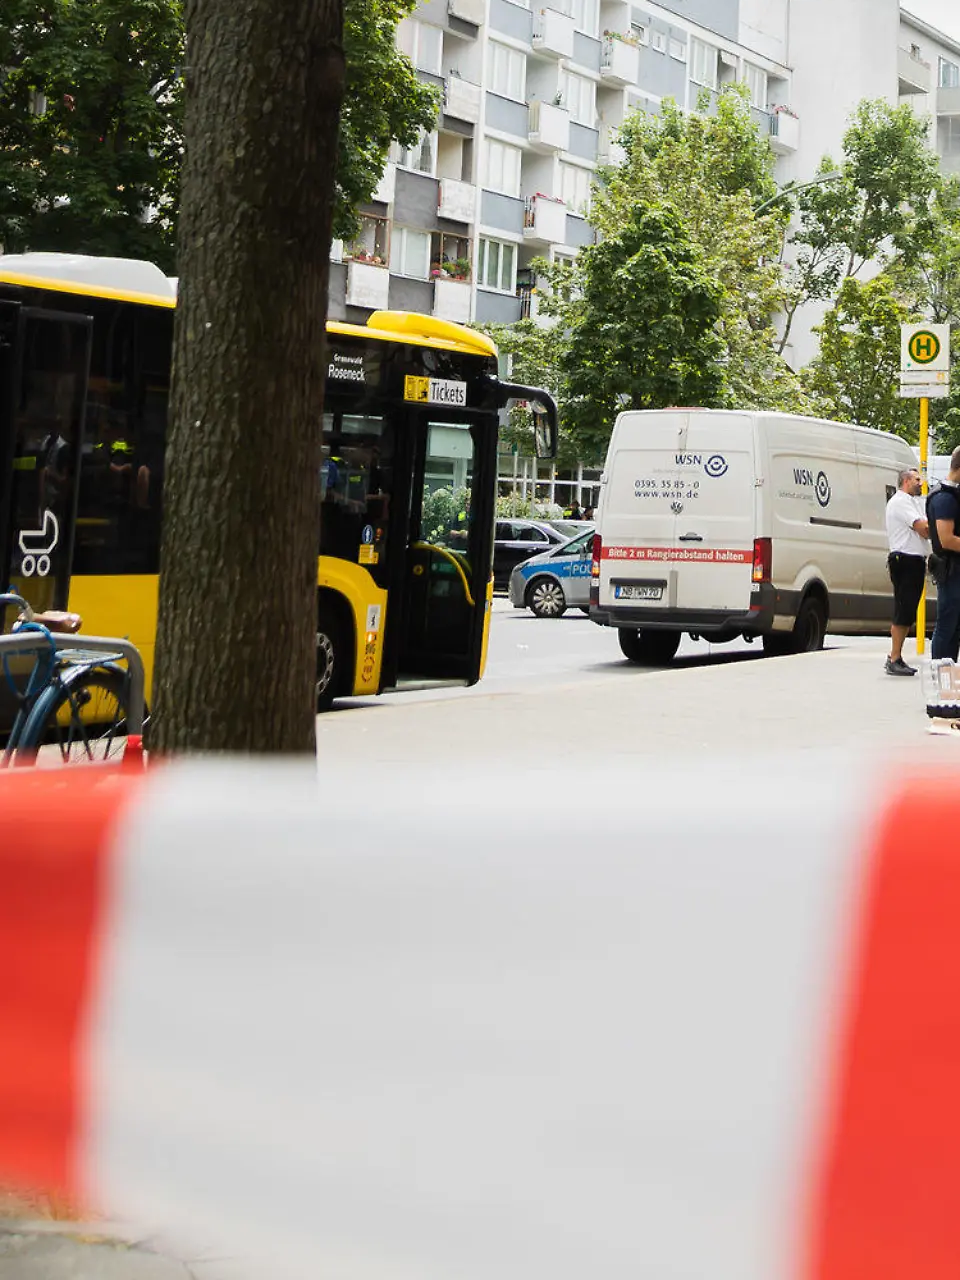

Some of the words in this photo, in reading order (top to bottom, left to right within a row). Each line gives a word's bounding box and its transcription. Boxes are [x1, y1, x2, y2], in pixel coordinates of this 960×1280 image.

[916, 338, 931, 356] H
[328, 363, 365, 381] Roseneck
[431, 382, 464, 403] Tickets
[675, 455, 702, 465] WSN
[793, 468, 813, 486] WSN
[634, 490, 699, 499] www.wsn.de
[629, 549, 635, 558] 2
[716, 551, 744, 561] halten
